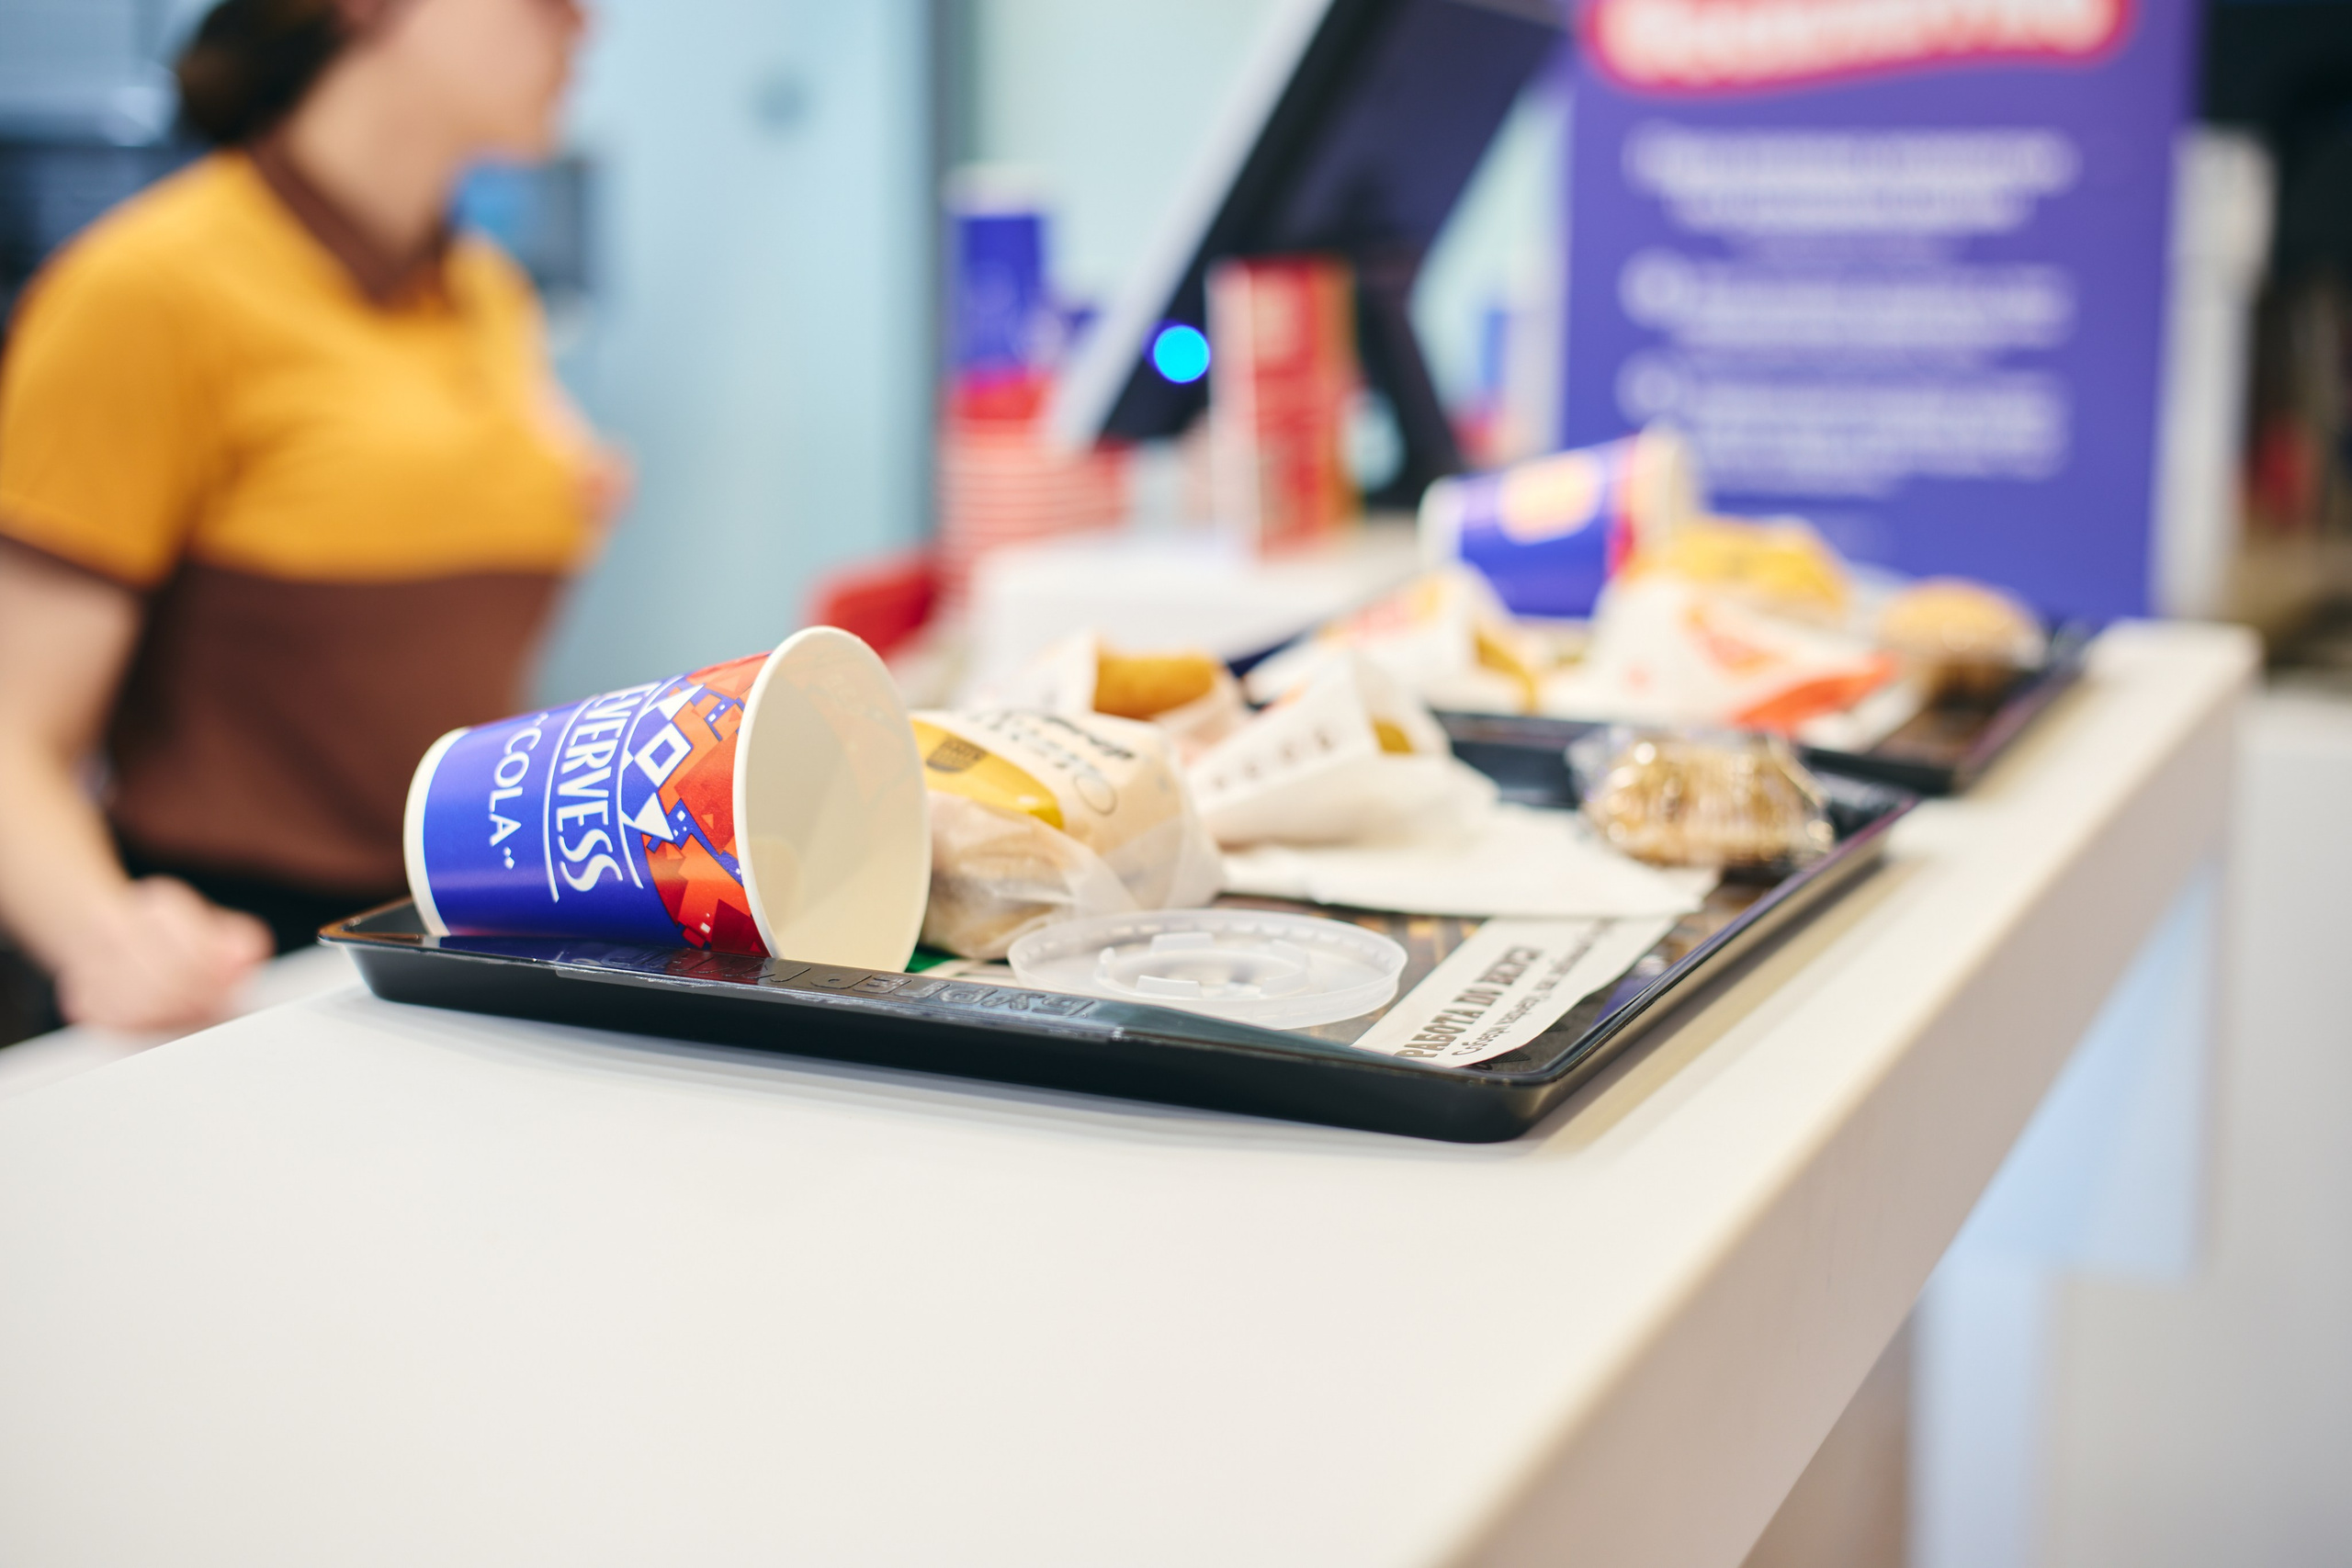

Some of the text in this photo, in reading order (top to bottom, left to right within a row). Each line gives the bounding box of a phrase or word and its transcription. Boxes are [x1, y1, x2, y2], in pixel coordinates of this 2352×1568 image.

[489, 727, 542, 847] COLA
[557, 682, 663, 892] EVERVESS
[1394, 1009, 1486, 1058] РАБОТА
